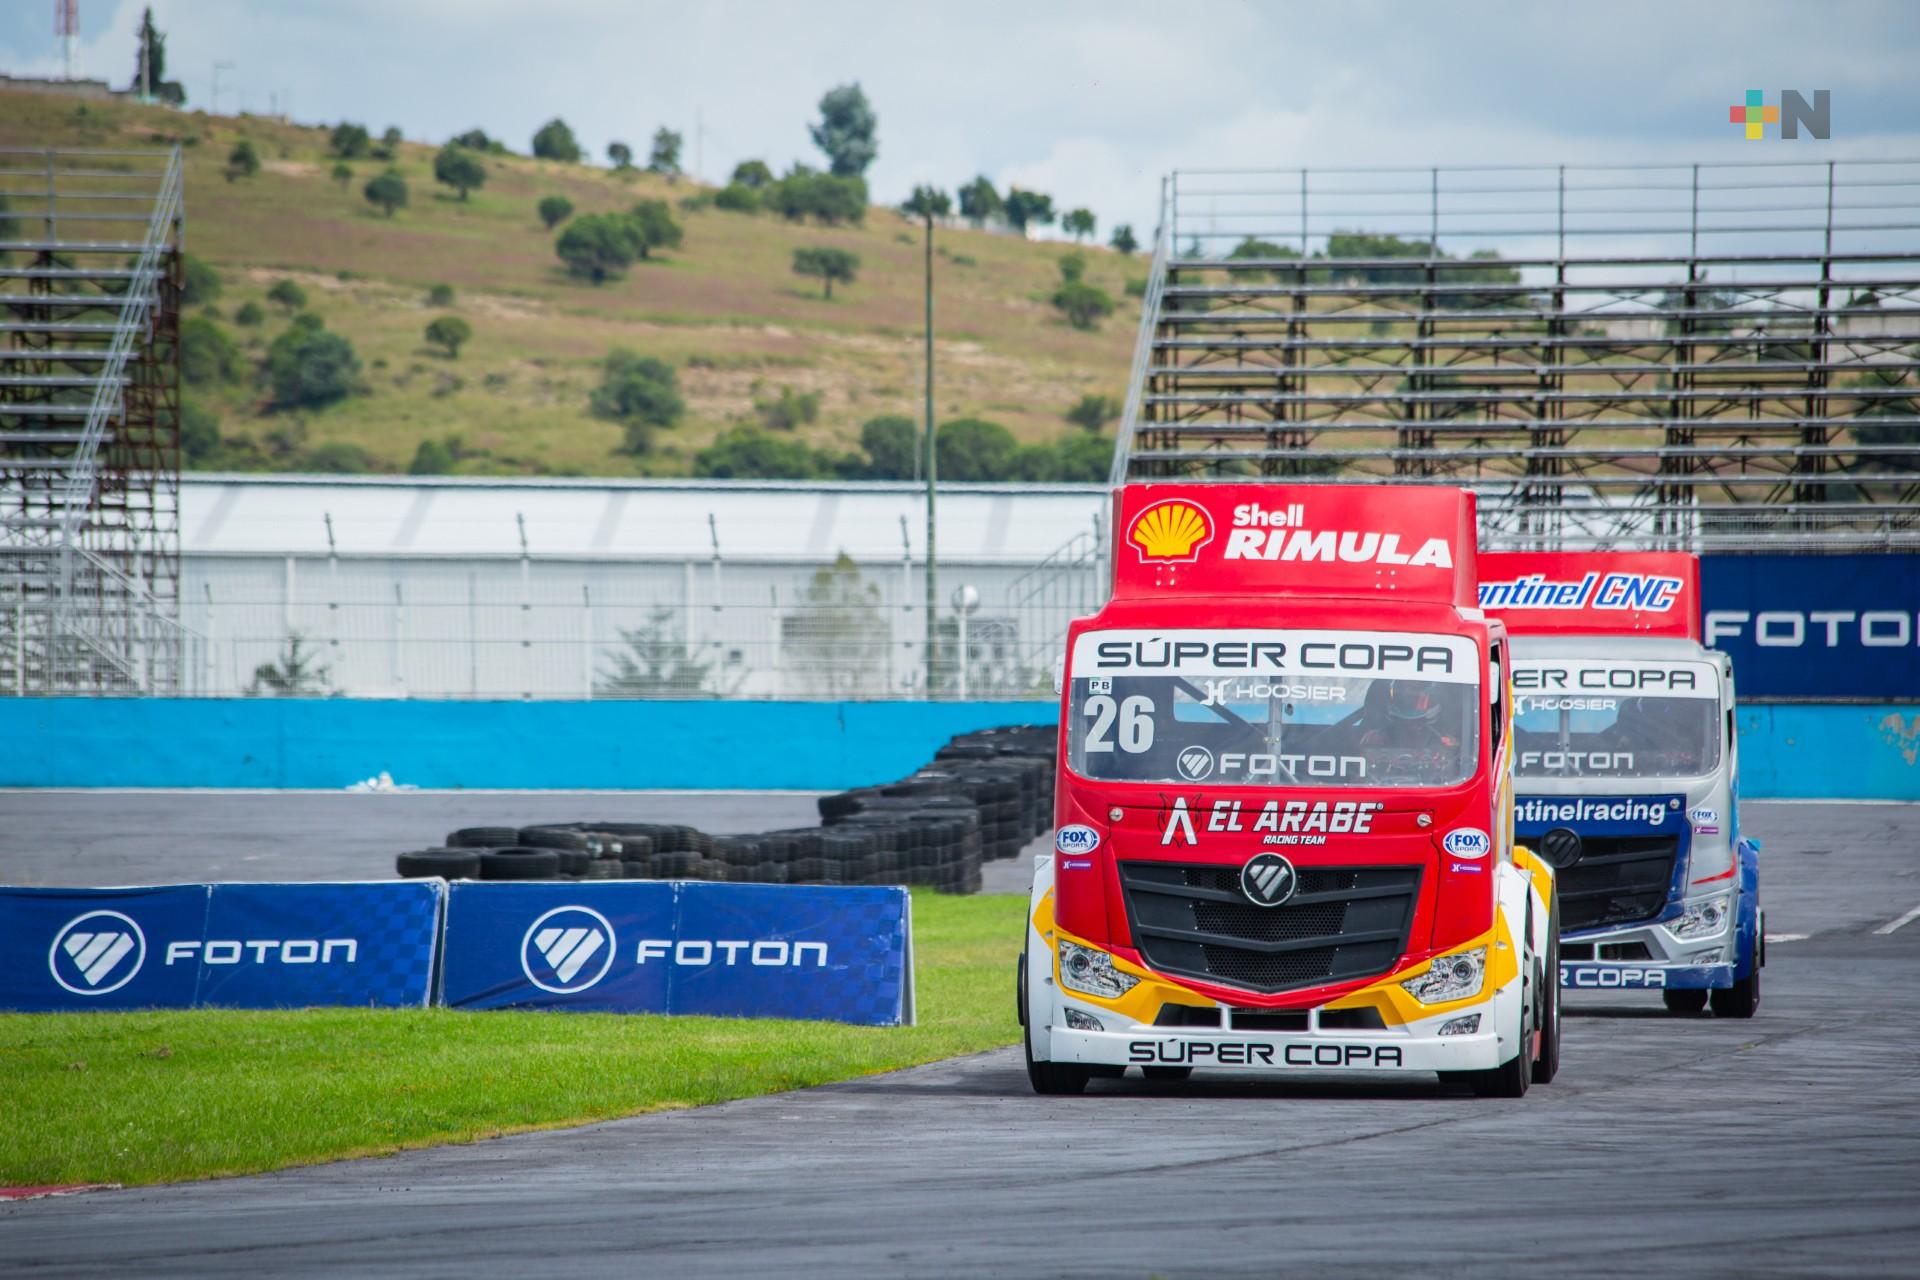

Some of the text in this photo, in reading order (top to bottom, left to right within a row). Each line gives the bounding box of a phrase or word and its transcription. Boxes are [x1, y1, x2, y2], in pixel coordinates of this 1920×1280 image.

[1232, 503, 1304, 527] Shell
[1224, 528, 1453, 568] RIMULA
[1594, 574, 1682, 610] CNC
[1705, 611, 1920, 647] FOTO
[1097, 637, 1453, 673] SÚPER COPA
[1579, 669, 1696, 689] COPA
[1236, 684, 1346, 701] HOOSIER
[1531, 699, 1616, 711] HOOSIER
[1083, 694, 1155, 754] 26
[1219, 753, 1366, 777] FOTON
[1521, 752, 1634, 769] FOTON
[1207, 800, 1244, 832] EL
[1062, 831, 1087, 843] FOX
[1263, 835, 1327, 846] RACING TEAM
[1455, 834, 1481, 847] FOX
[165, 938, 358, 966] FOTON
[636, 939, 828, 967] FOTON
[1575, 968, 1666, 987] COPA
[1129, 1038, 1403, 1067] SÚPER COPA
